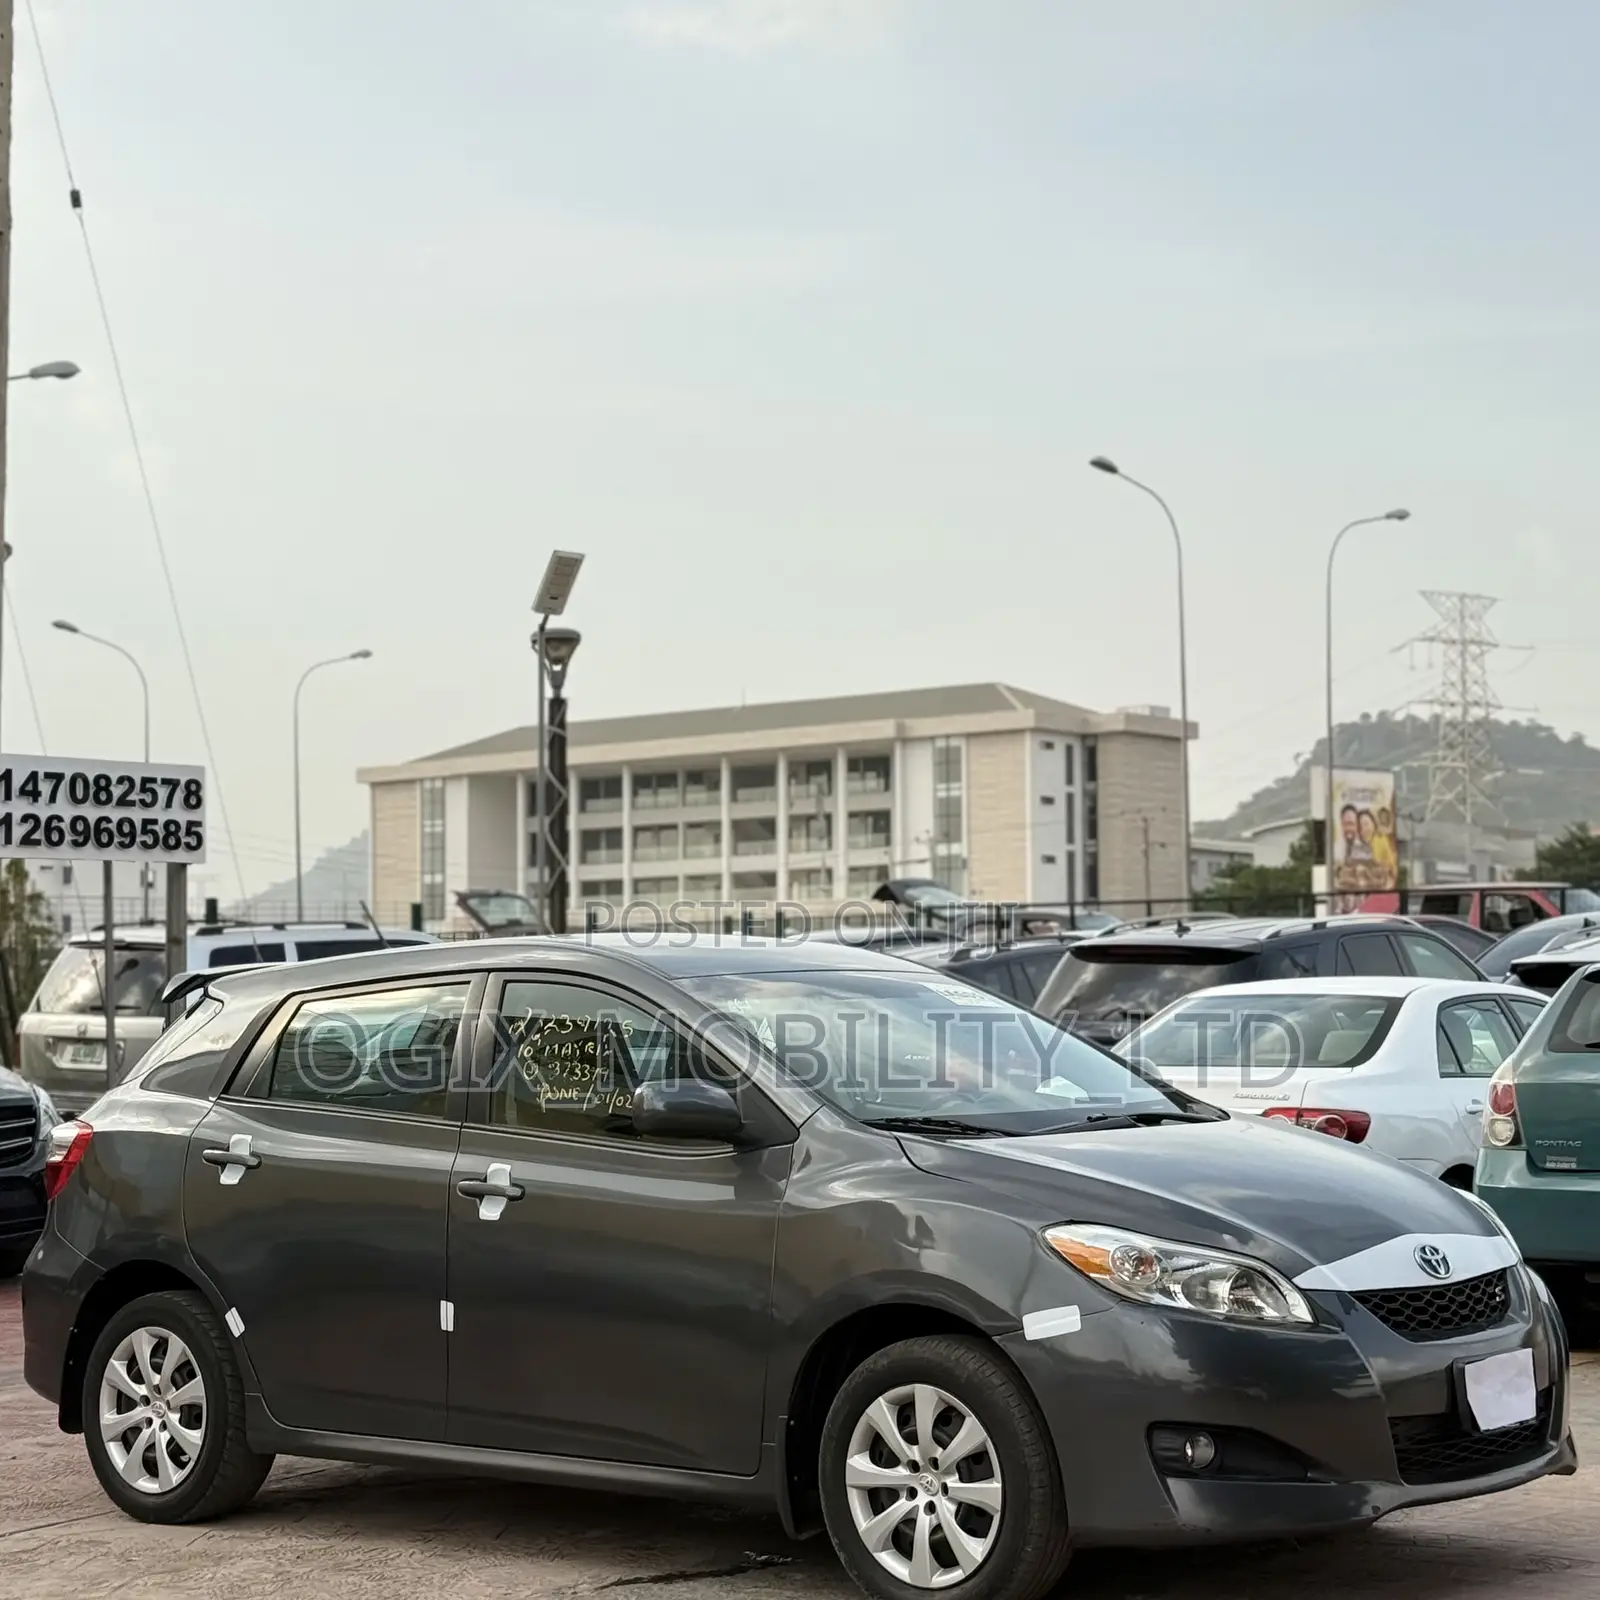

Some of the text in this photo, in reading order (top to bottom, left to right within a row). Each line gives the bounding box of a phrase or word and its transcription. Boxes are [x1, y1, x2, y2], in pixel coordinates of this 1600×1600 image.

[0, 768, 203, 810] 147082578
[0, 812, 203, 852] 126969585
[1535, 1139, 1583, 1148] PONTIAC
